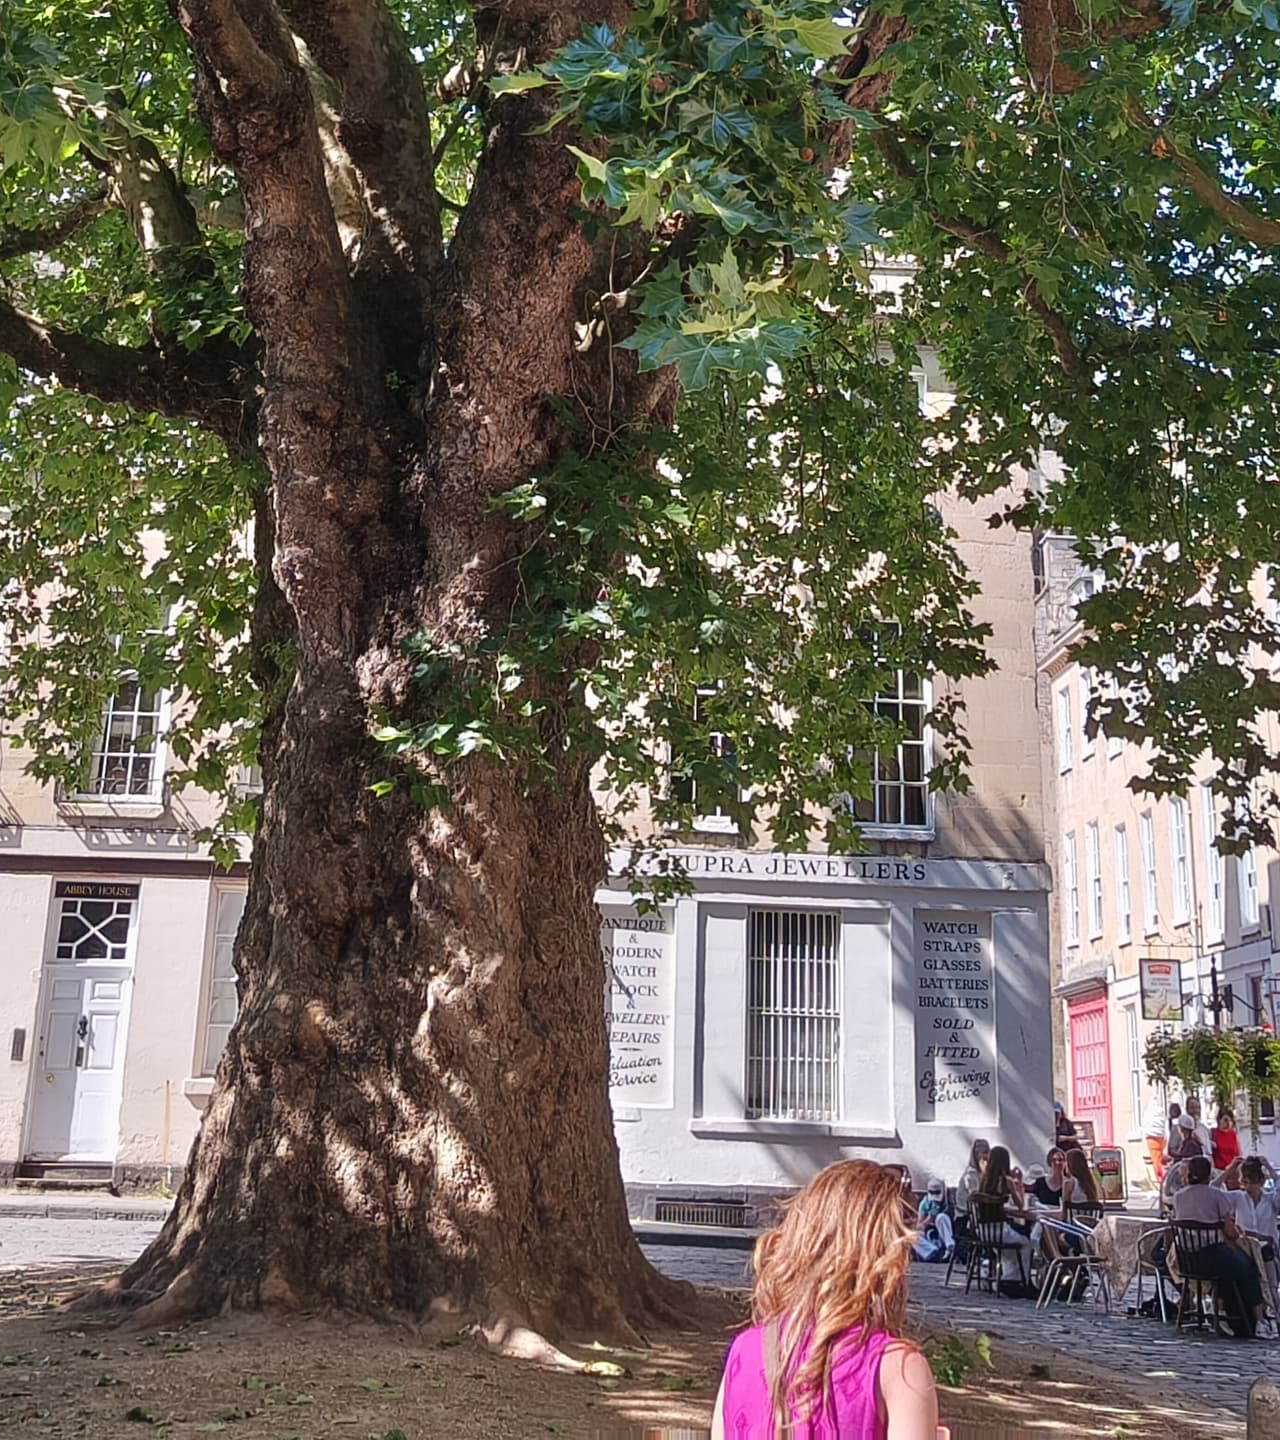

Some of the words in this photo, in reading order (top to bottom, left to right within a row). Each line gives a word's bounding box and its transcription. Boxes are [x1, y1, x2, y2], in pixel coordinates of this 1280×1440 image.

[765, 858, 926, 881] JEWELLERS
[98, 886, 131, 896] HOUSE
[601, 918, 666, 932] ANTIQUE
[923, 922, 978, 935] WATCH
[629, 933, 638, 944] &
[604, 946, 662, 959] MODERN
[923, 940, 981, 953] STRAPS
[923, 959, 981, 971] GLASSES
[919, 977, 989, 990] BATTERIES
[608, 984, 659, 997] CLOCK
[919, 996, 989, 1009] BRACELETS
[604, 1012, 670, 1026] EWELLERY
[933, 1018, 974, 1030] SOLD
[608, 1031, 661, 1045] EPAIRS
[949, 1032, 960, 1043] &
[924, 1046, 980, 1058] FITTED
[920, 1070, 991, 1091] Engraving
[927, 1086, 980, 1104] Service
